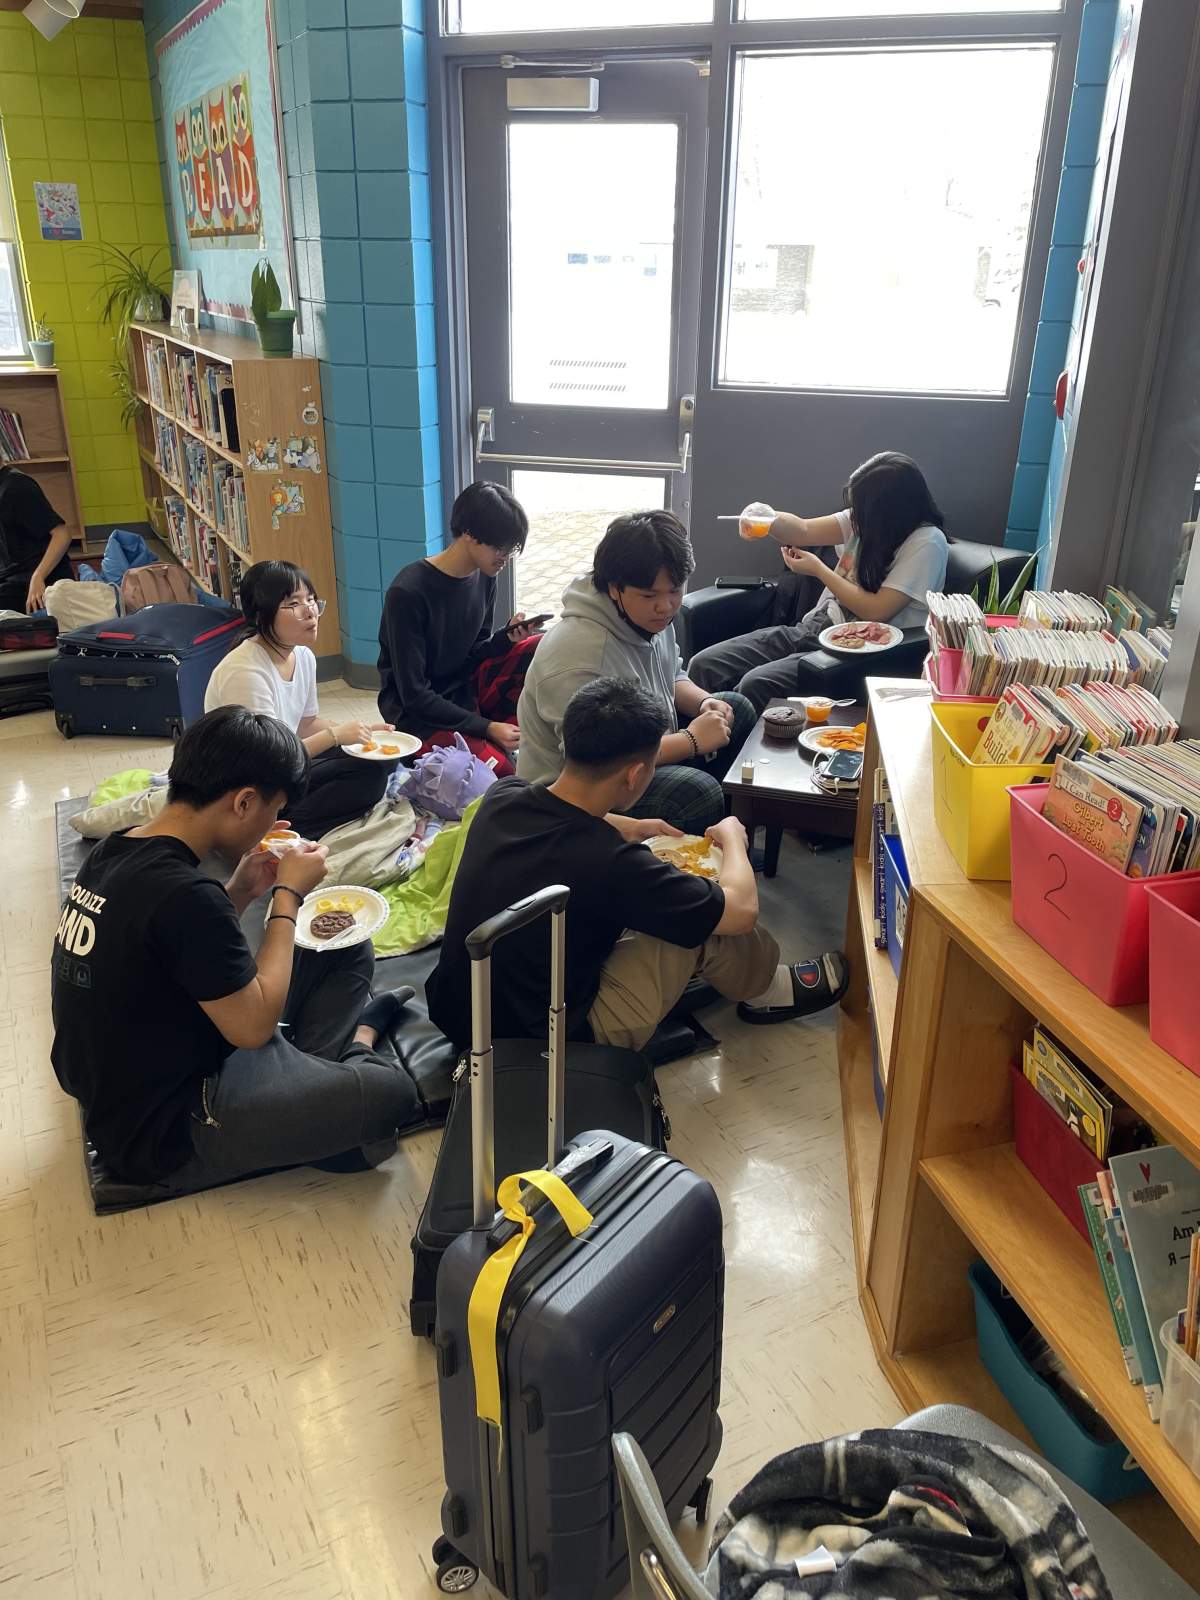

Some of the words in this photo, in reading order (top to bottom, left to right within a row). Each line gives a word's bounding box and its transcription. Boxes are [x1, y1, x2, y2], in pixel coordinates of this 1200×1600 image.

[181, 150, 253, 215] READ
[1070, 784, 1085, 799] Can
[1084, 791, 1107, 809] Read!
[1111, 803, 1119, 815] 2
[1062, 813, 1081, 836] Lost
[1083, 829, 1106, 854] Tooth
[1073, 802, 1105, 832] Gilbert
[1043, 853, 1072, 921] 2
